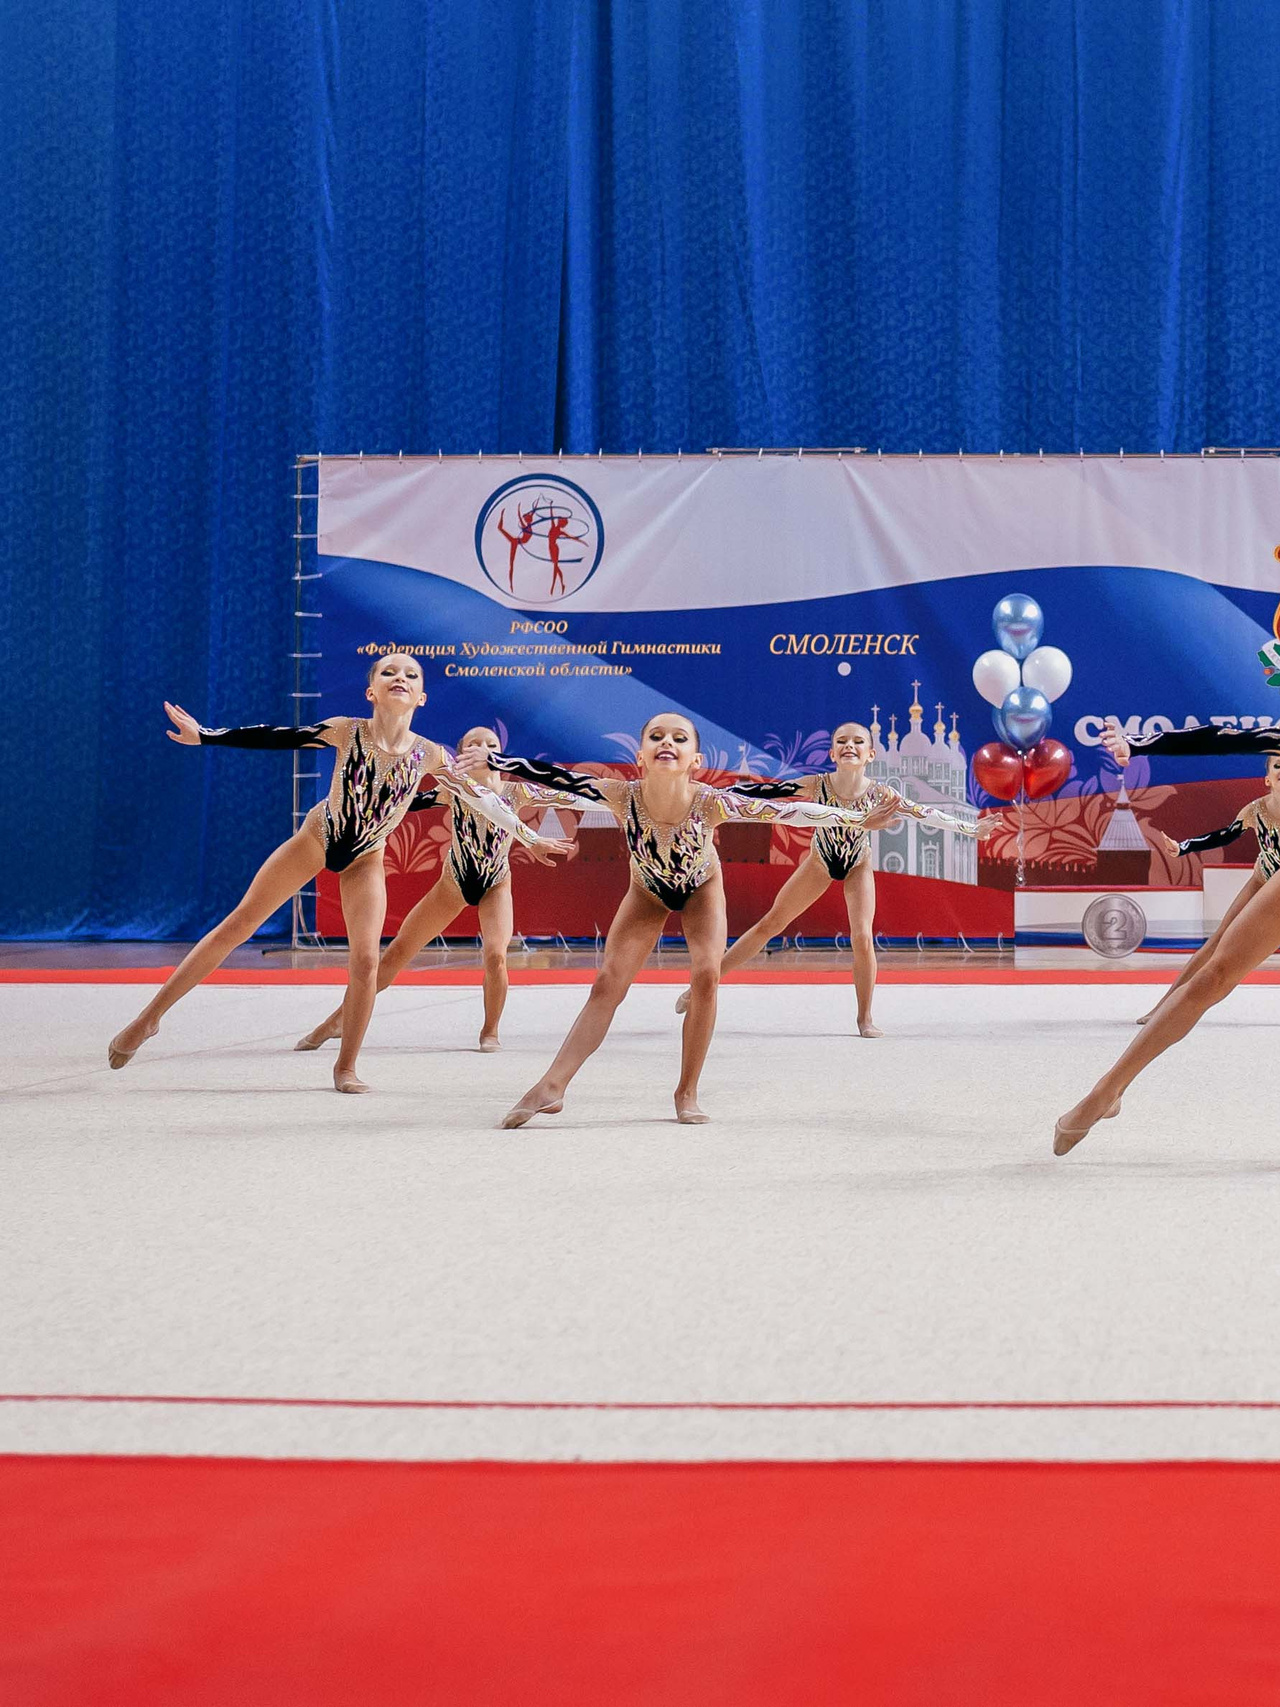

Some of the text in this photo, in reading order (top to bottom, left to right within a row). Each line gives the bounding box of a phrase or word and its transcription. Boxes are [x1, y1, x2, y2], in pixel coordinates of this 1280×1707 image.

[509, 620, 569, 634] РФСОО
[357, 641, 722, 658] «Федерация Художественной Гимнастики
[769, 633, 920, 655] СМОЛЕНСК
[445, 662, 633, 677] Смоленской области»
[1102, 909, 1128, 940] 2
